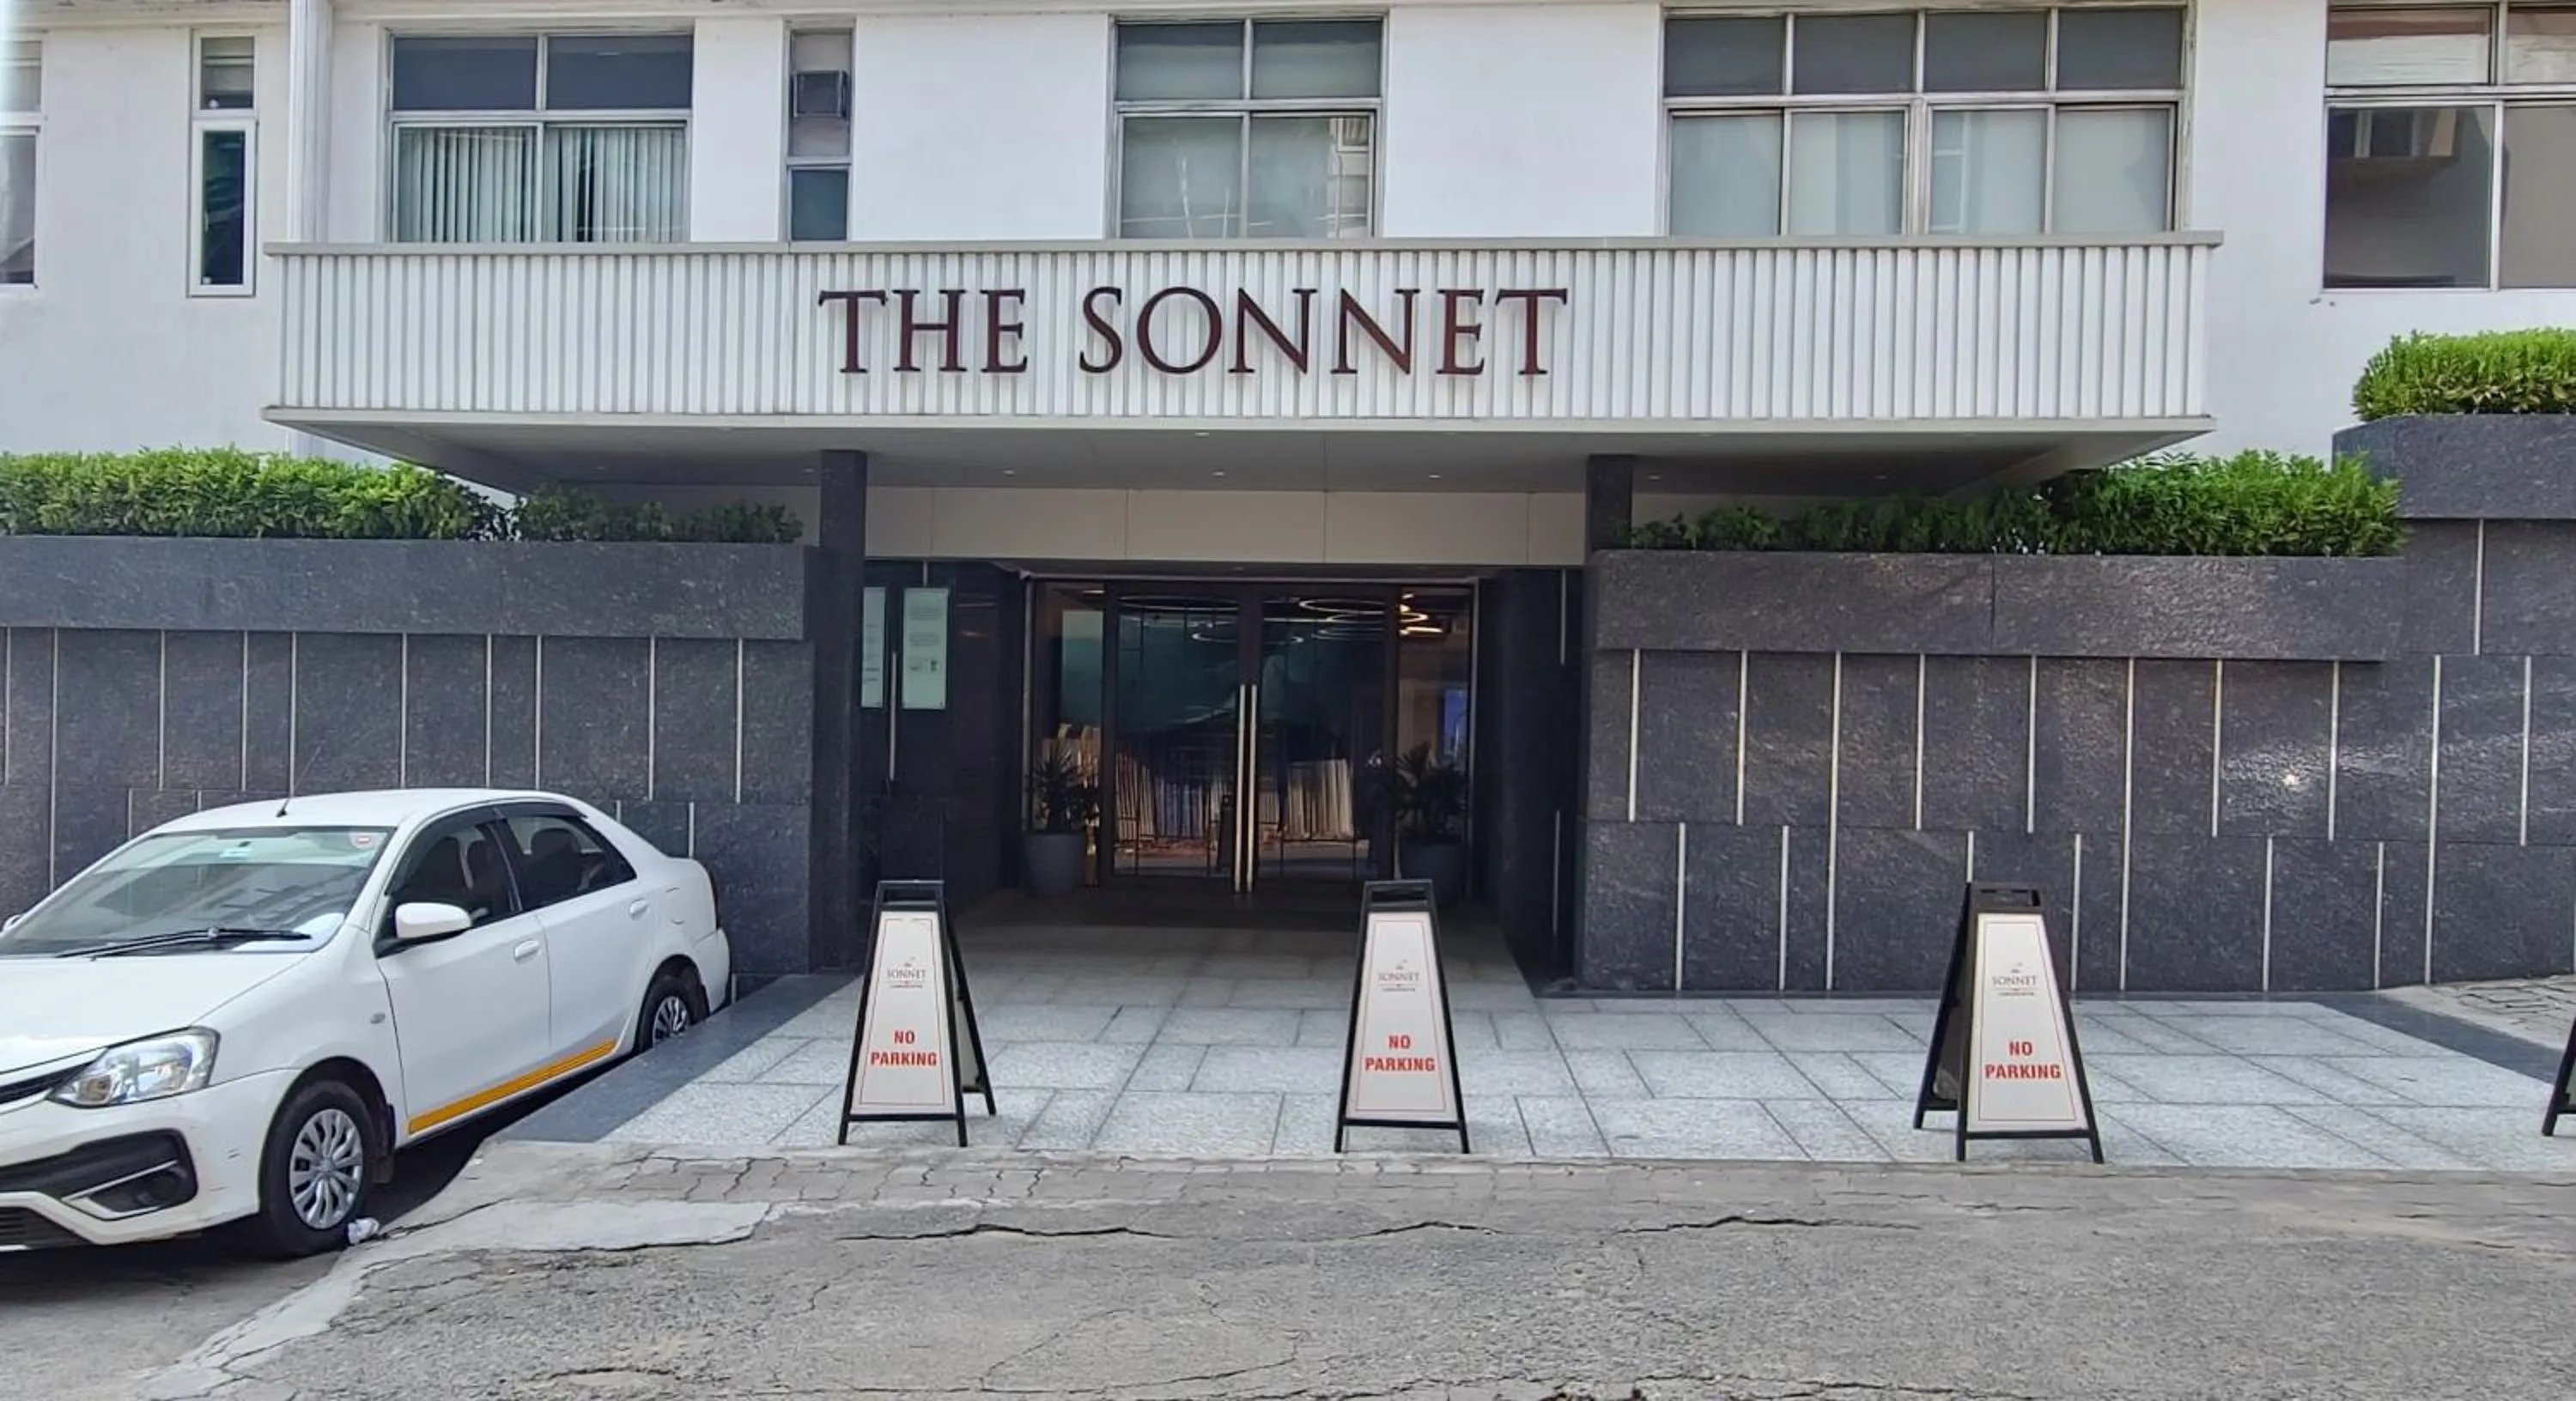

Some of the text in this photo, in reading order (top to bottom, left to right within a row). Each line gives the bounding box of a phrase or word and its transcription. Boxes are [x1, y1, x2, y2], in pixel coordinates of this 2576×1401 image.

[818, 286, 1569, 375] THE SONNET
[894, 1029, 915, 1045] NO
[1388, 1034, 1411, 1049] NO
[2009, 1040, 2032, 1057] NO
[871, 1052, 937, 1066] PARKING
[1365, 1058, 1436, 1071] PARKING
[1985, 1064, 2062, 1079] PARKING
